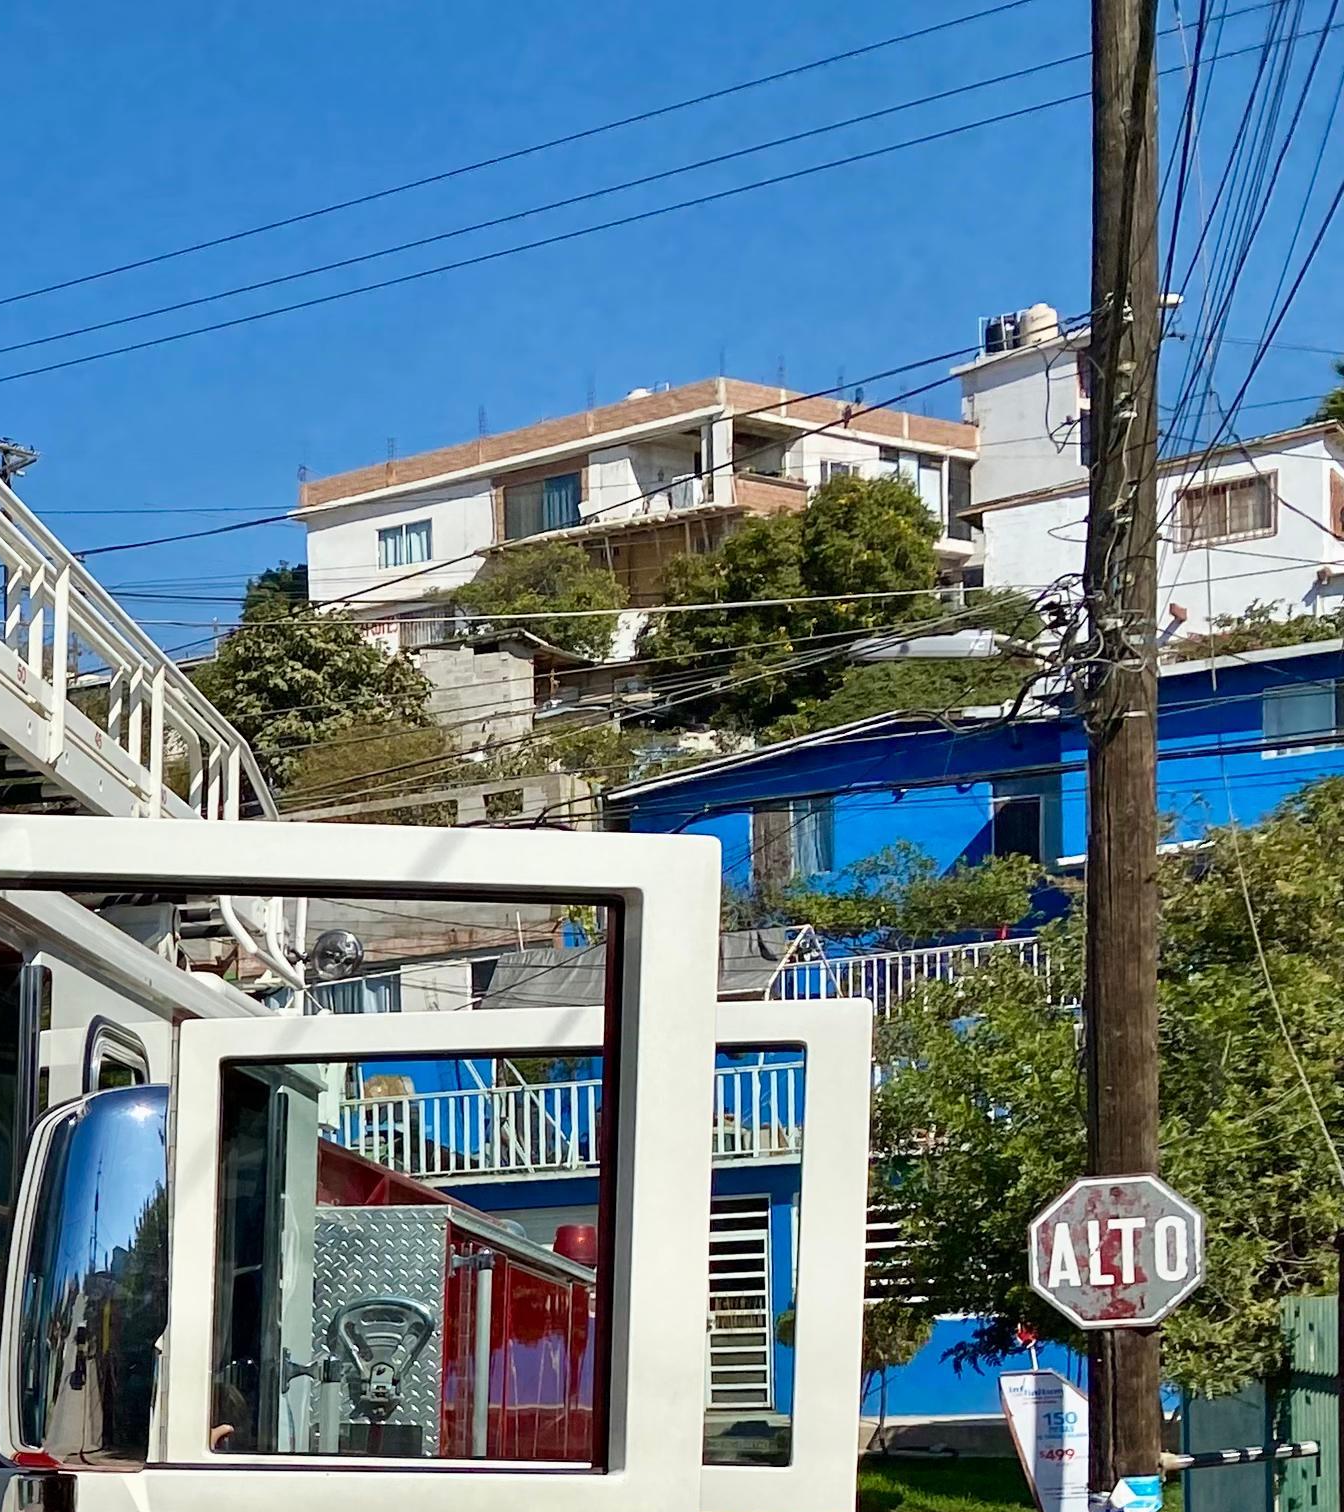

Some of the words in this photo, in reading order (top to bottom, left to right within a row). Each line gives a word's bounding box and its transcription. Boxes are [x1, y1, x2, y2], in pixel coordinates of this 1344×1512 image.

[16, 662, 27, 685] 50
[1048, 1215, 1189, 1288] ALTO
[1042, 1411, 1078, 1426] 150
